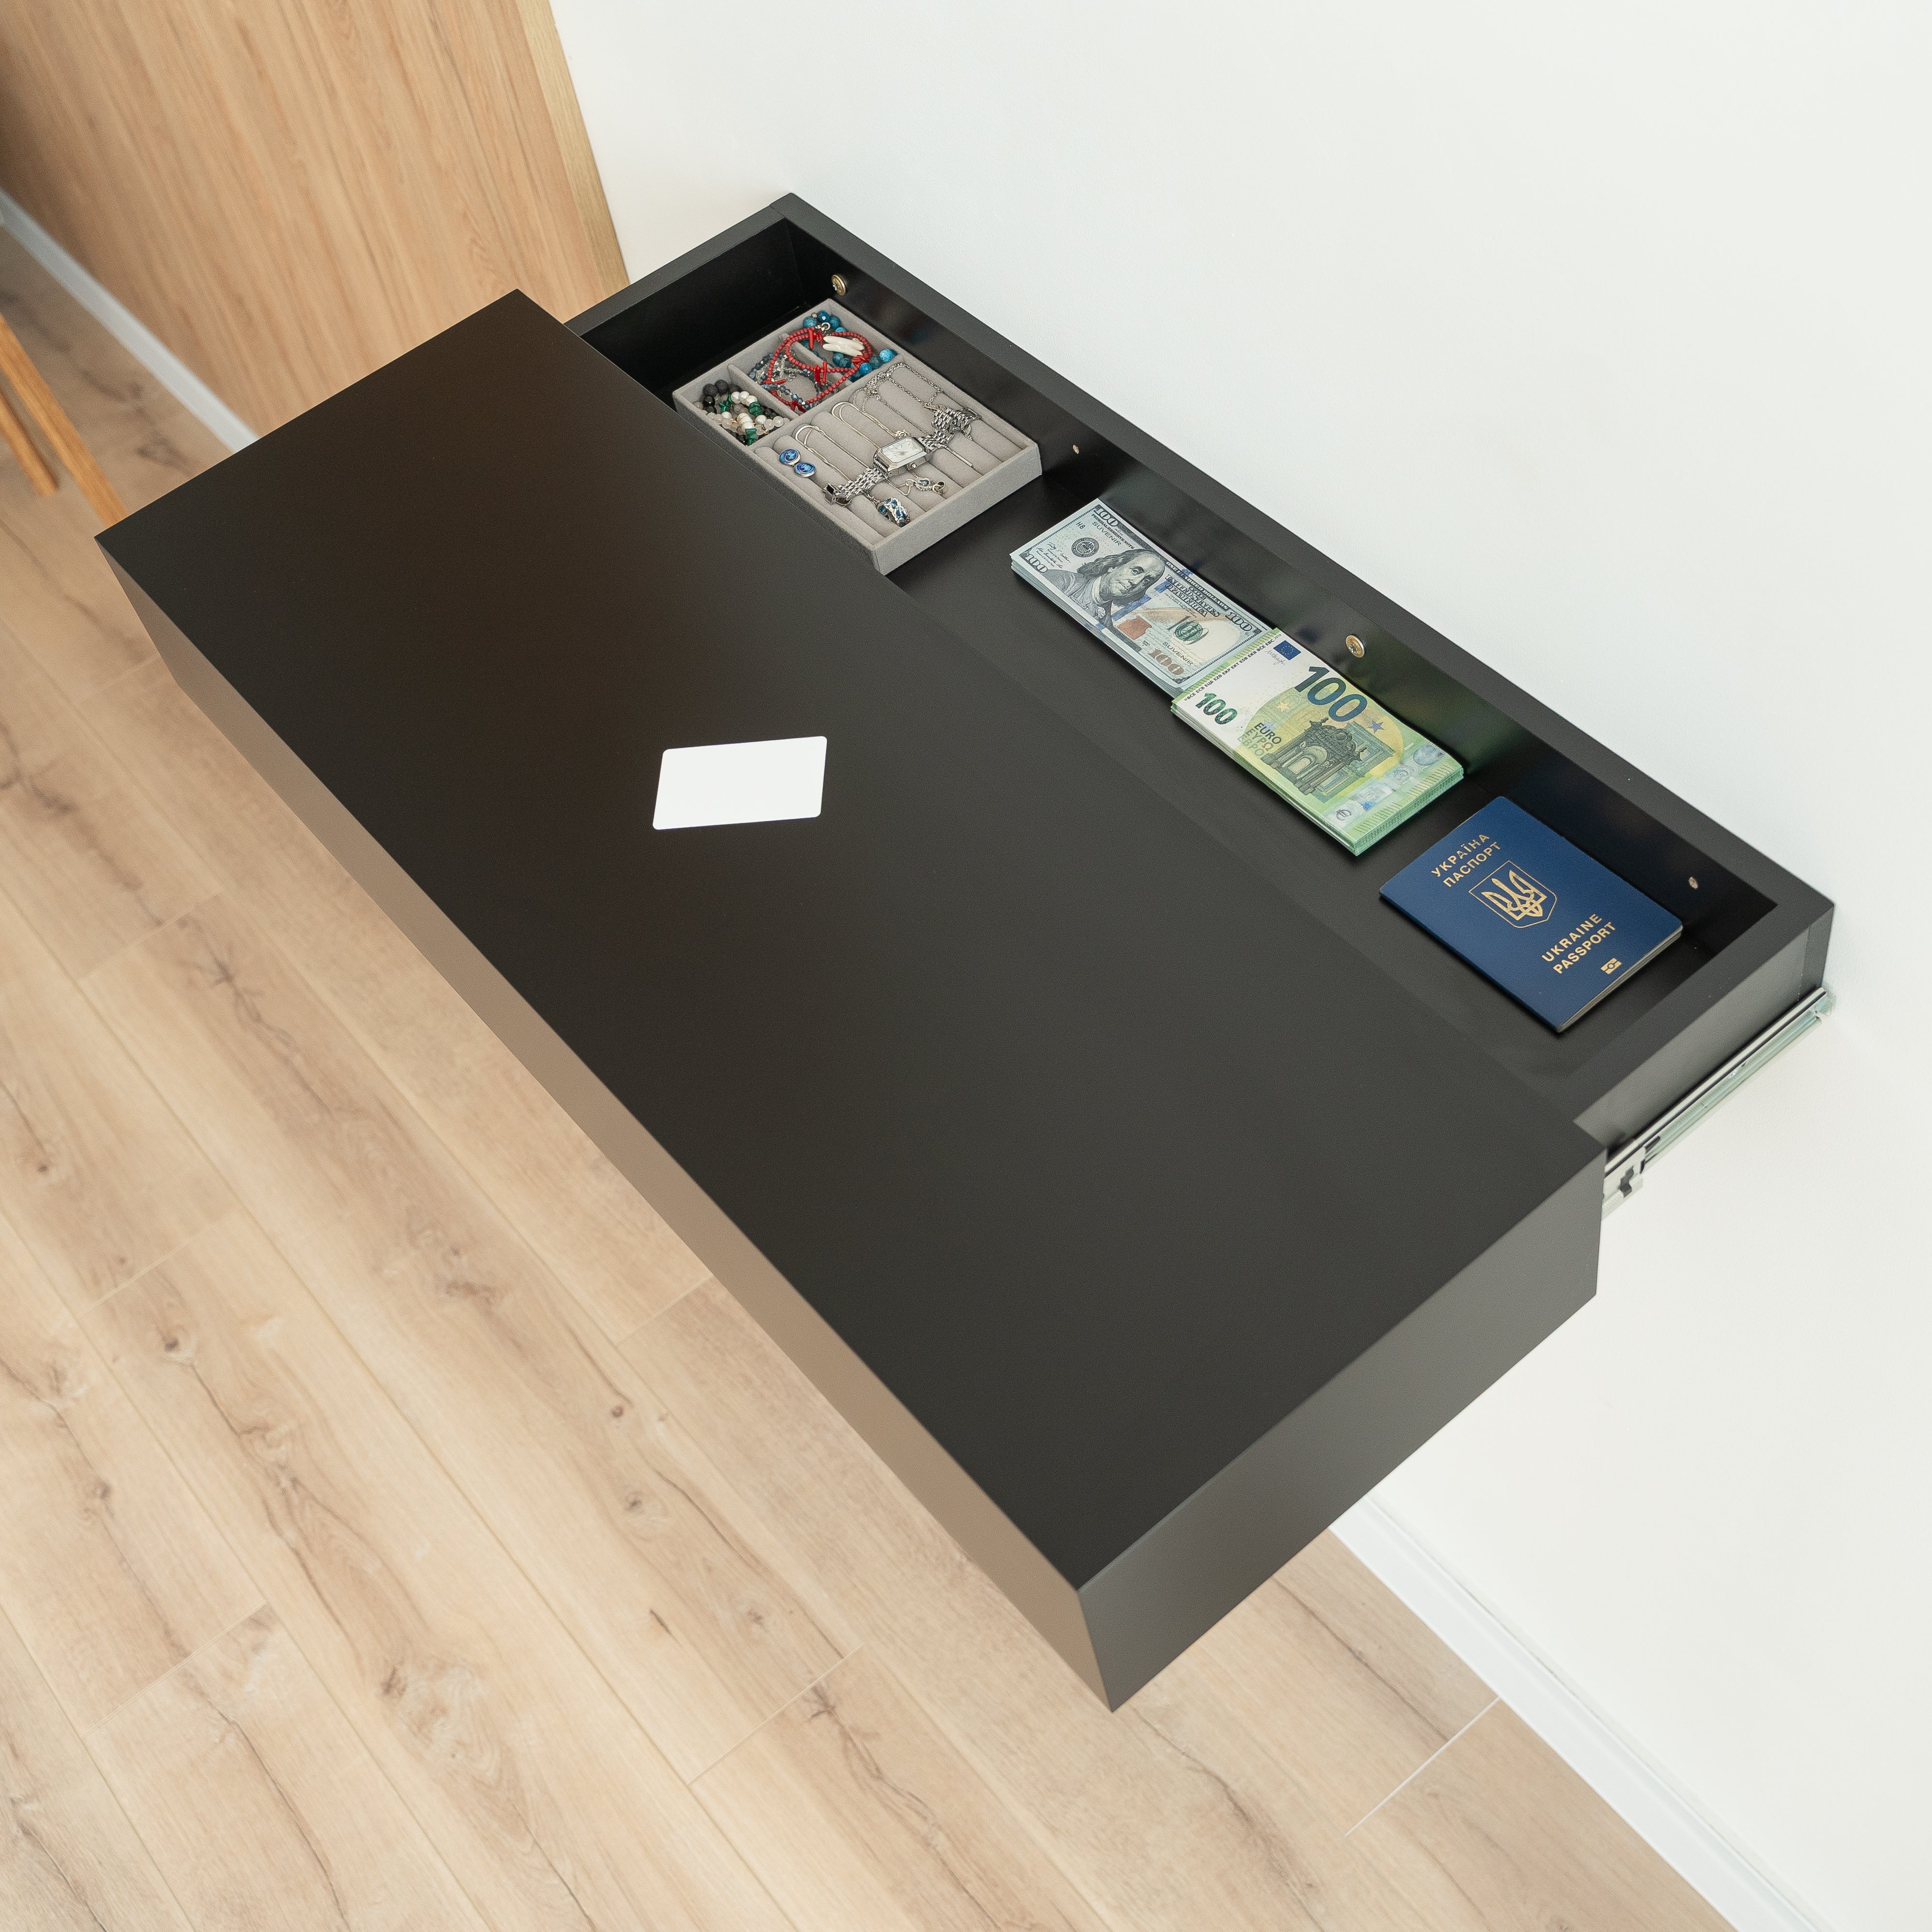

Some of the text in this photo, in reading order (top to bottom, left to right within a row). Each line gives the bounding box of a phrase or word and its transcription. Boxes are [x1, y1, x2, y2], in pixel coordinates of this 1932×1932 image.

[1091, 513, 1108, 528] FEDERAL
[1106, 526, 1125, 541] RESERVE
[1123, 540, 1135, 549] NOTE
[1094, 506, 1119, 527] 100
[1092, 521, 1122, 546] SUVENIR
[1024, 554, 1048, 573] 100
[1164, 583, 1178, 593] OF
[1173, 590, 1209, 617] AMERICA
[1165, 574, 1194, 597] UNITED
[1190, 595, 1221, 617] STATES
[1225, 611, 1253, 632] 100
[1148, 648, 1184, 675] 100
[1162, 641, 1193, 666] SUVENIR
[1195, 693, 1237, 724] 100
[1294, 666, 1367, 722] 100
[1254, 722, 1281, 744] EURO
[1431, 834, 1490, 877] УКРАЇНА
[1442, 841, 1500, 887] ПАСПОРТ
[1541, 914, 1602, 962] UKRAINE
[1552, 922, 1615, 974] PASSPORT
